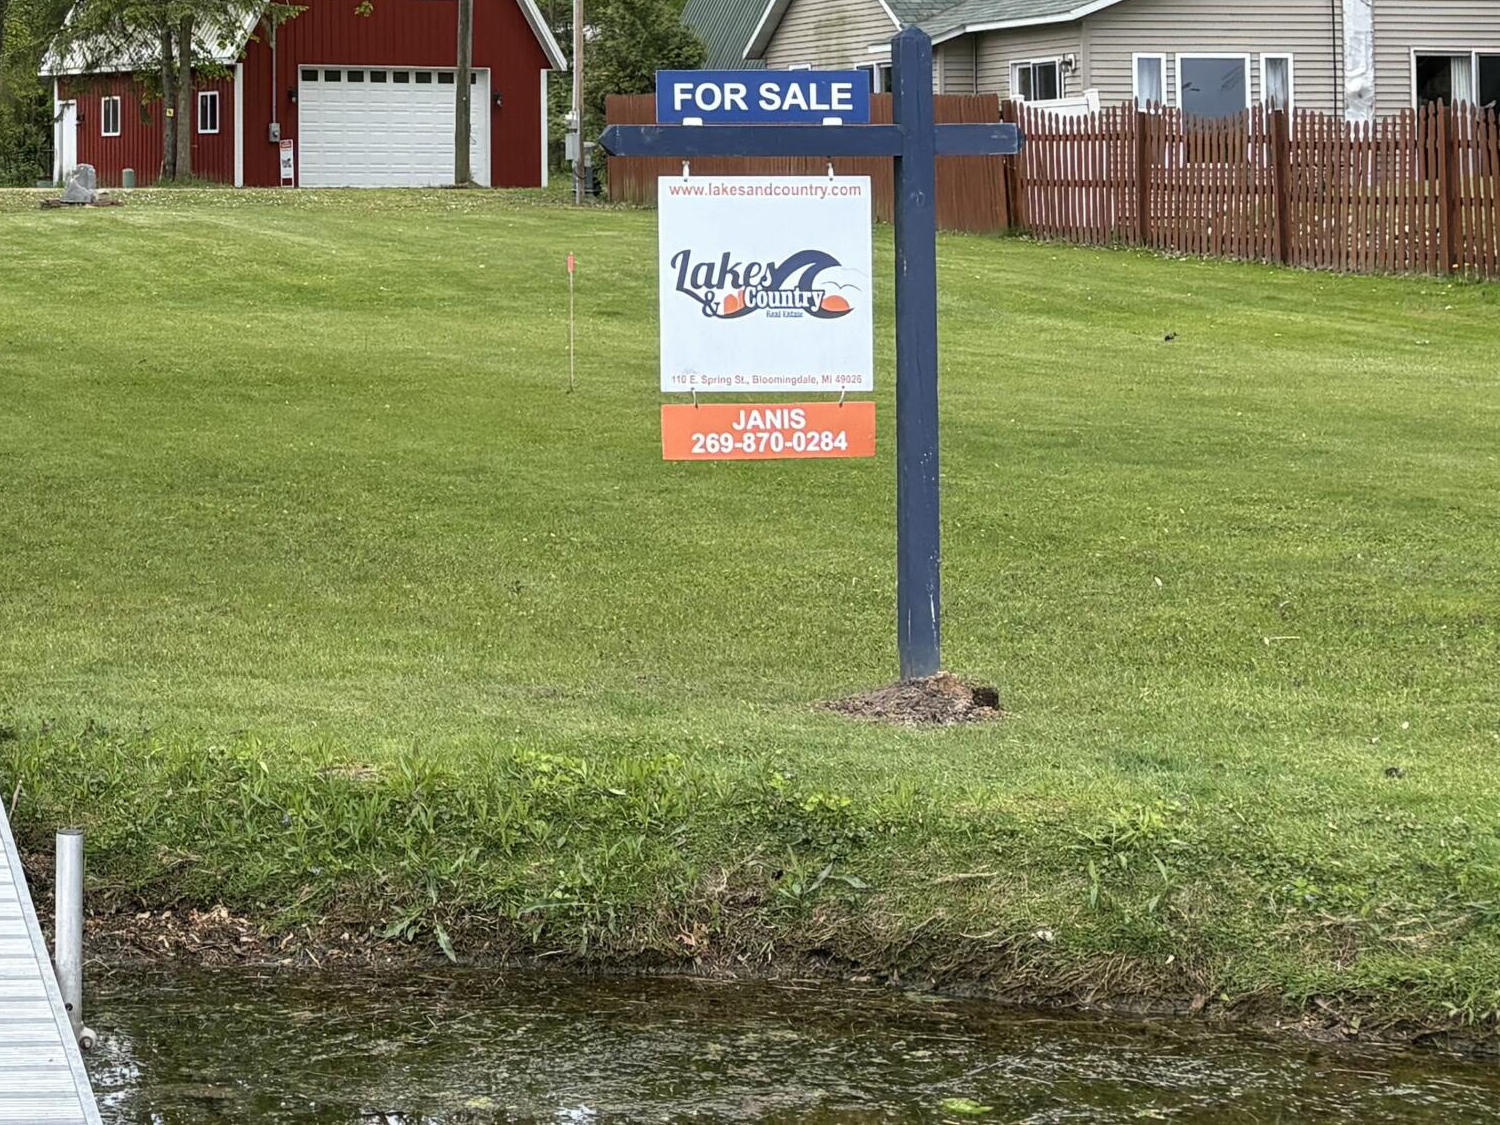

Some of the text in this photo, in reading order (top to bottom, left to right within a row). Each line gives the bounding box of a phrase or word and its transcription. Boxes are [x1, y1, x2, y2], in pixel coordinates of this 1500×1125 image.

[673, 82, 853, 111] FOR SALE
[669, 183, 862, 199] www.lakesandcountry.com
[670, 249, 775, 290] Lakes
[702, 286, 825, 317] & Country
[701, 375, 732, 386] Spring
[752, 375, 819, 386] Bloomingdale,
[821, 375, 832, 384] MI
[732, 408, 806, 430] JANIS
[691, 431, 848, 454] 269-870-0284
